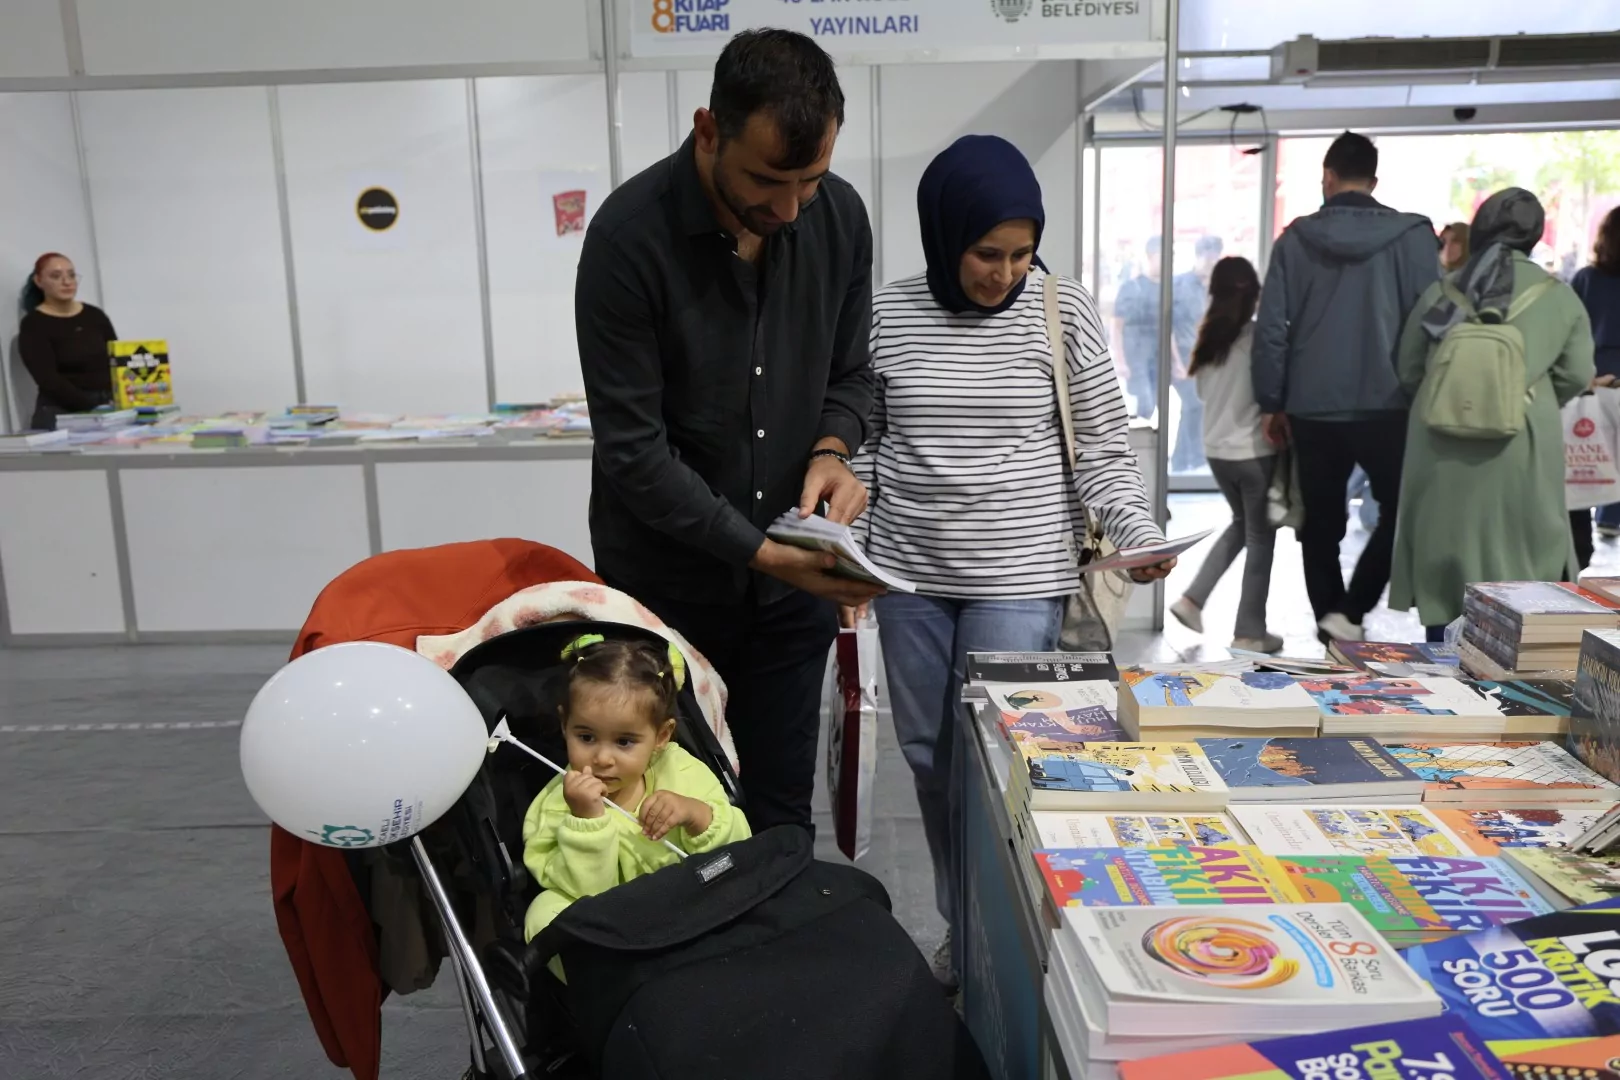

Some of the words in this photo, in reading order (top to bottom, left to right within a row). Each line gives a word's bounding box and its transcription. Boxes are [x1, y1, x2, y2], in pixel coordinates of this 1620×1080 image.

[1041, 1, 1139, 18] BELEDİYESİ
[675, 14, 729, 33] FUARI
[810, 14, 919, 35] YAYINLARI
[1296, 911, 1335, 939] Dersler
[1327, 920, 1353, 939] Tüm
[1328, 941, 1378, 956] 8
[1339, 957, 1368, 995] Bankası
[1361, 958, 1384, 982] Soru
[1479, 948, 1577, 1011] 500
[1523, 936, 1620, 1010] KRİTİK
[1442, 958, 1519, 1018] SORU
